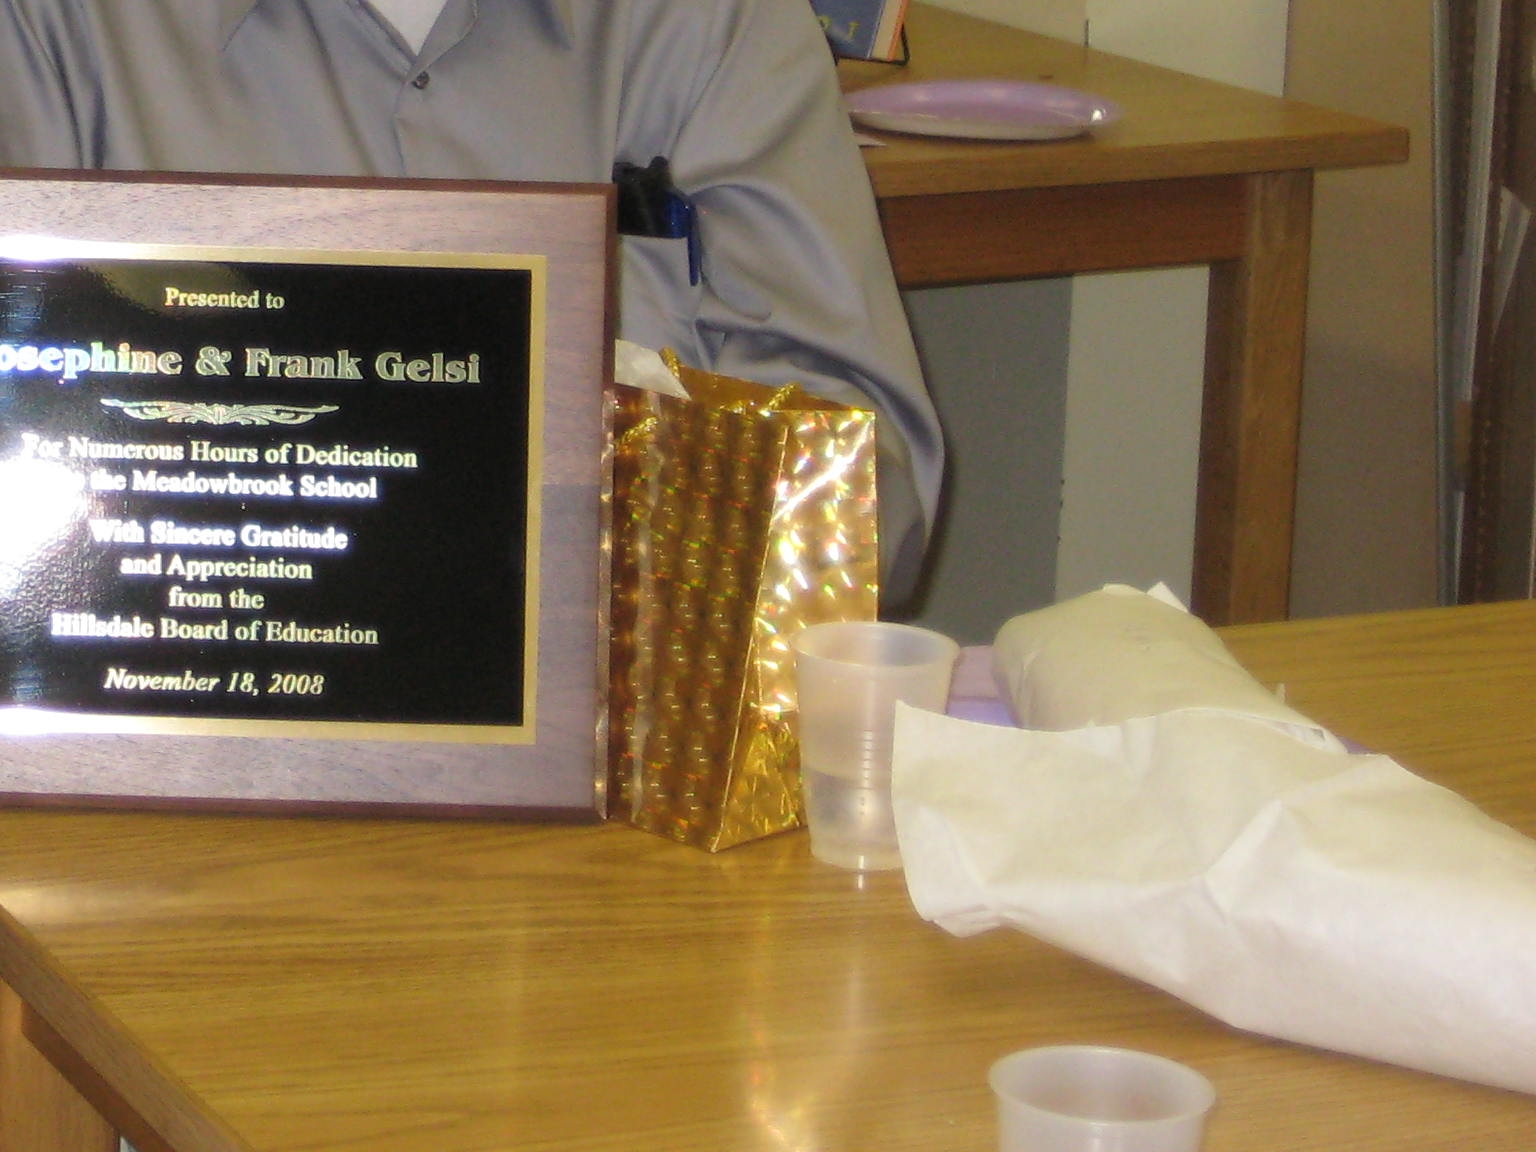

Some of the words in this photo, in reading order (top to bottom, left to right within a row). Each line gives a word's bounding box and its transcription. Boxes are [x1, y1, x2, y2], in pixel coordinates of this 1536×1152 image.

[164, 286, 260, 310] Presented
[266, 290, 286, 310] to
[195, 345, 233, 377] &
[244, 347, 364, 381] Frank
[374, 350, 481, 384] Gelsi
[21, 431, 64, 458] For
[68, 435, 185, 462] Numerous
[190, 440, 259, 464] Hours
[265, 443, 293, 465] of
[296, 444, 419, 469] Dedication
[90, 468, 127, 491] the
[132, 469, 295, 498] Meadowbrook
[300, 474, 378, 500] School
[89, 518, 145, 543] With
[150, 520, 236, 546] Sincere
[241, 524, 349, 550] Gratitude
[120, 553, 162, 576] and
[166, 554, 313, 583] Appreciation
[168, 586, 223, 609] from
[229, 588, 265, 610] the
[51, 612, 155, 639] Hillsdale
[160, 617, 229, 641] Board
[234, 619, 262, 642] of
[265, 621, 380, 646] Education
[103, 667, 221, 694] November
[226, 671, 260, 697] 18,
[268, 673, 325, 696] 2008
